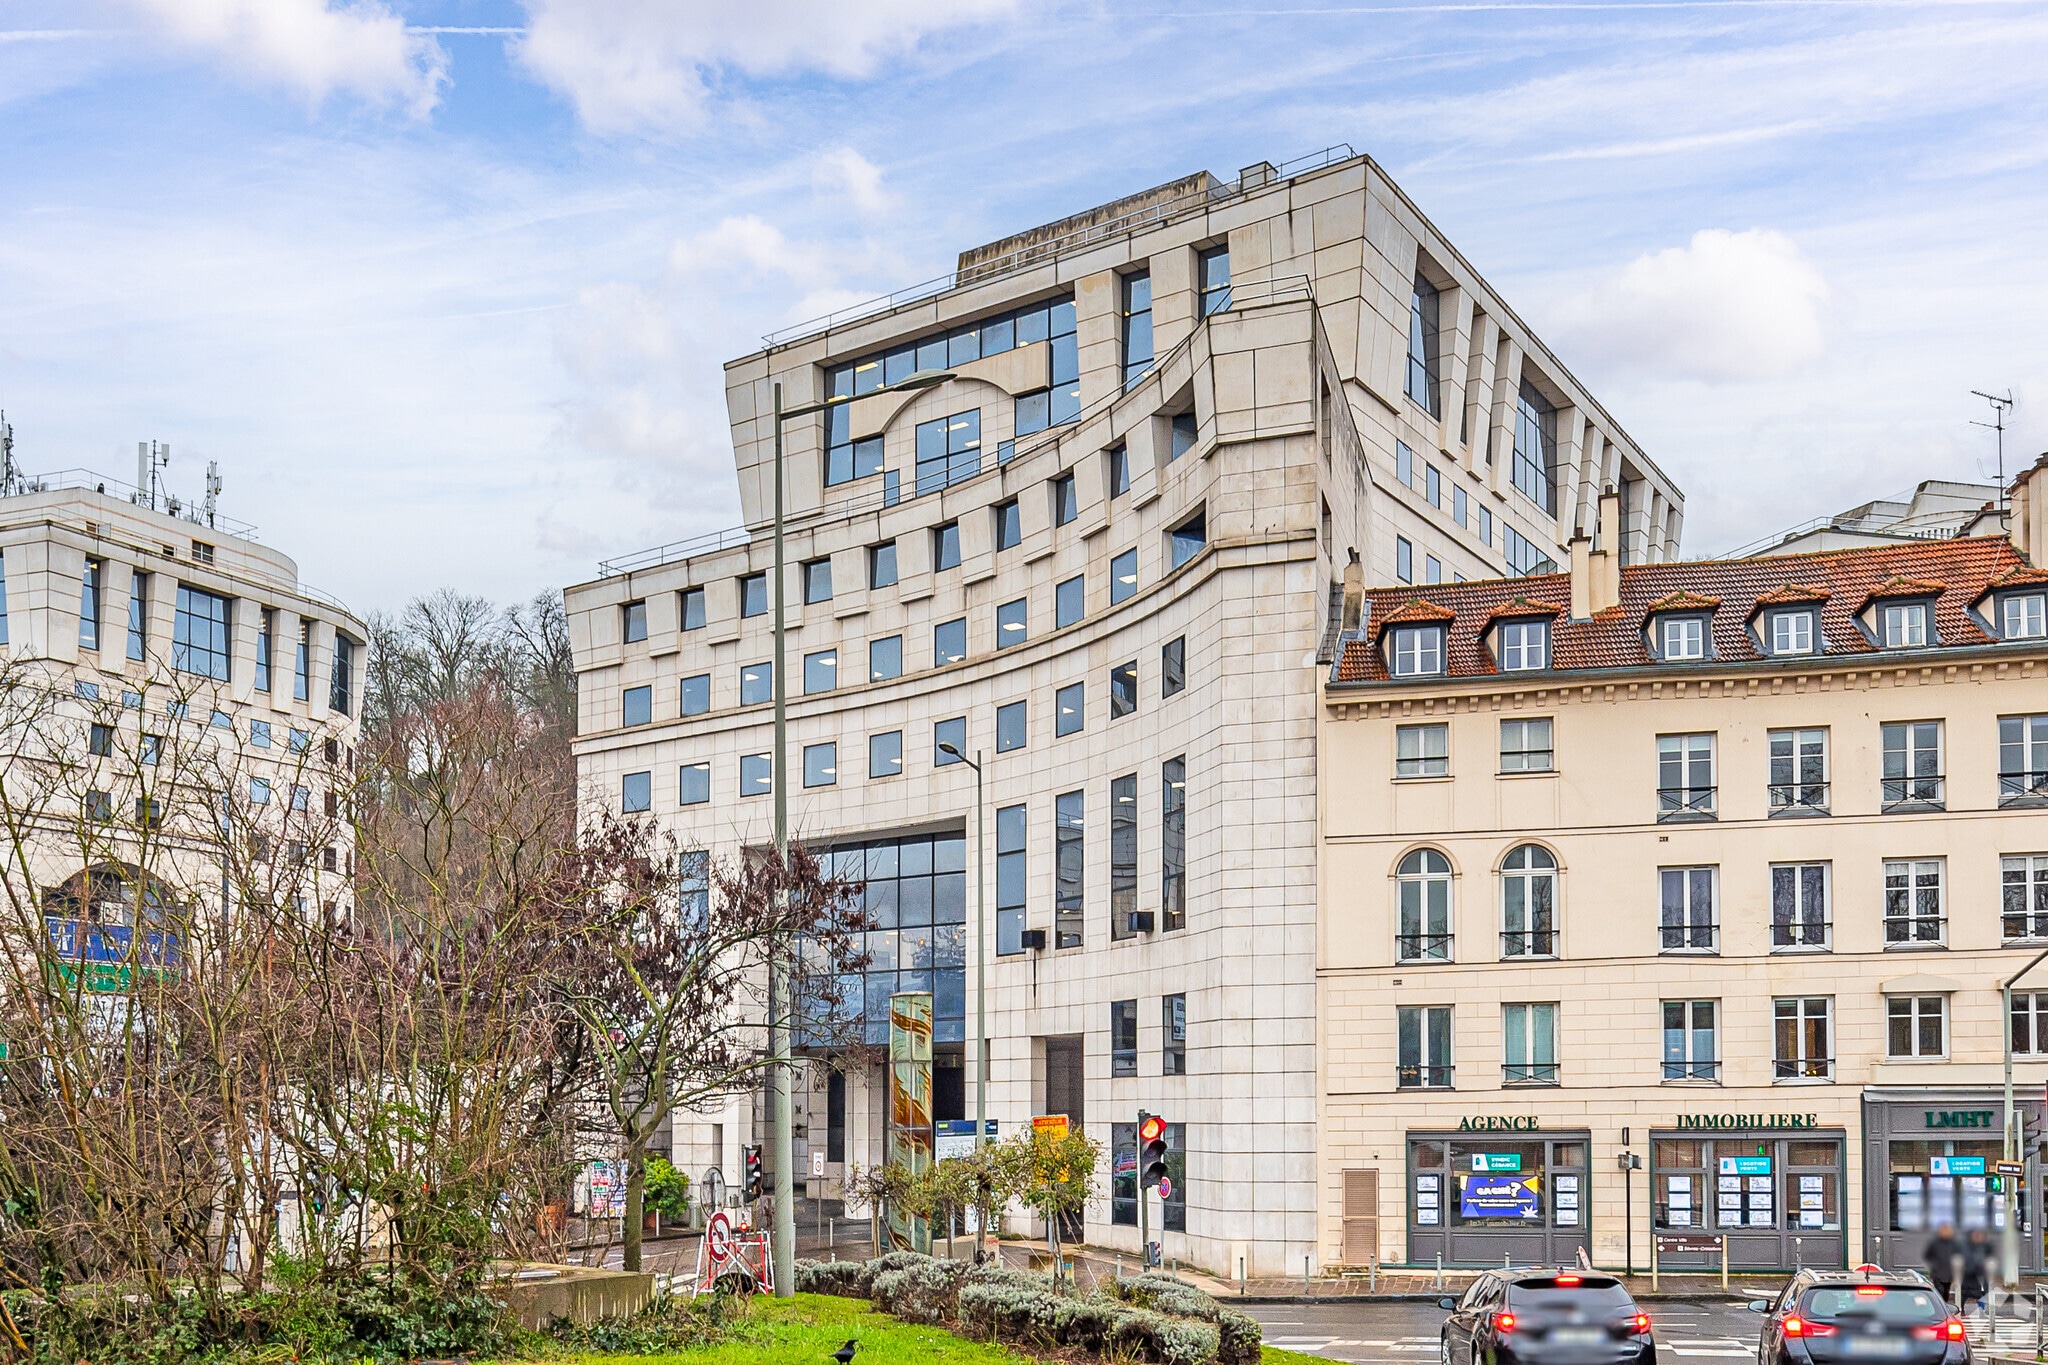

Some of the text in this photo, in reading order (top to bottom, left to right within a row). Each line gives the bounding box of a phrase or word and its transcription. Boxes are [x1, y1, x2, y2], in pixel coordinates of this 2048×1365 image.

[1458, 1113, 1818, 1131] AGENCE IMMOBILIERE
[1925, 1110, 1995, 1127] LMHT
